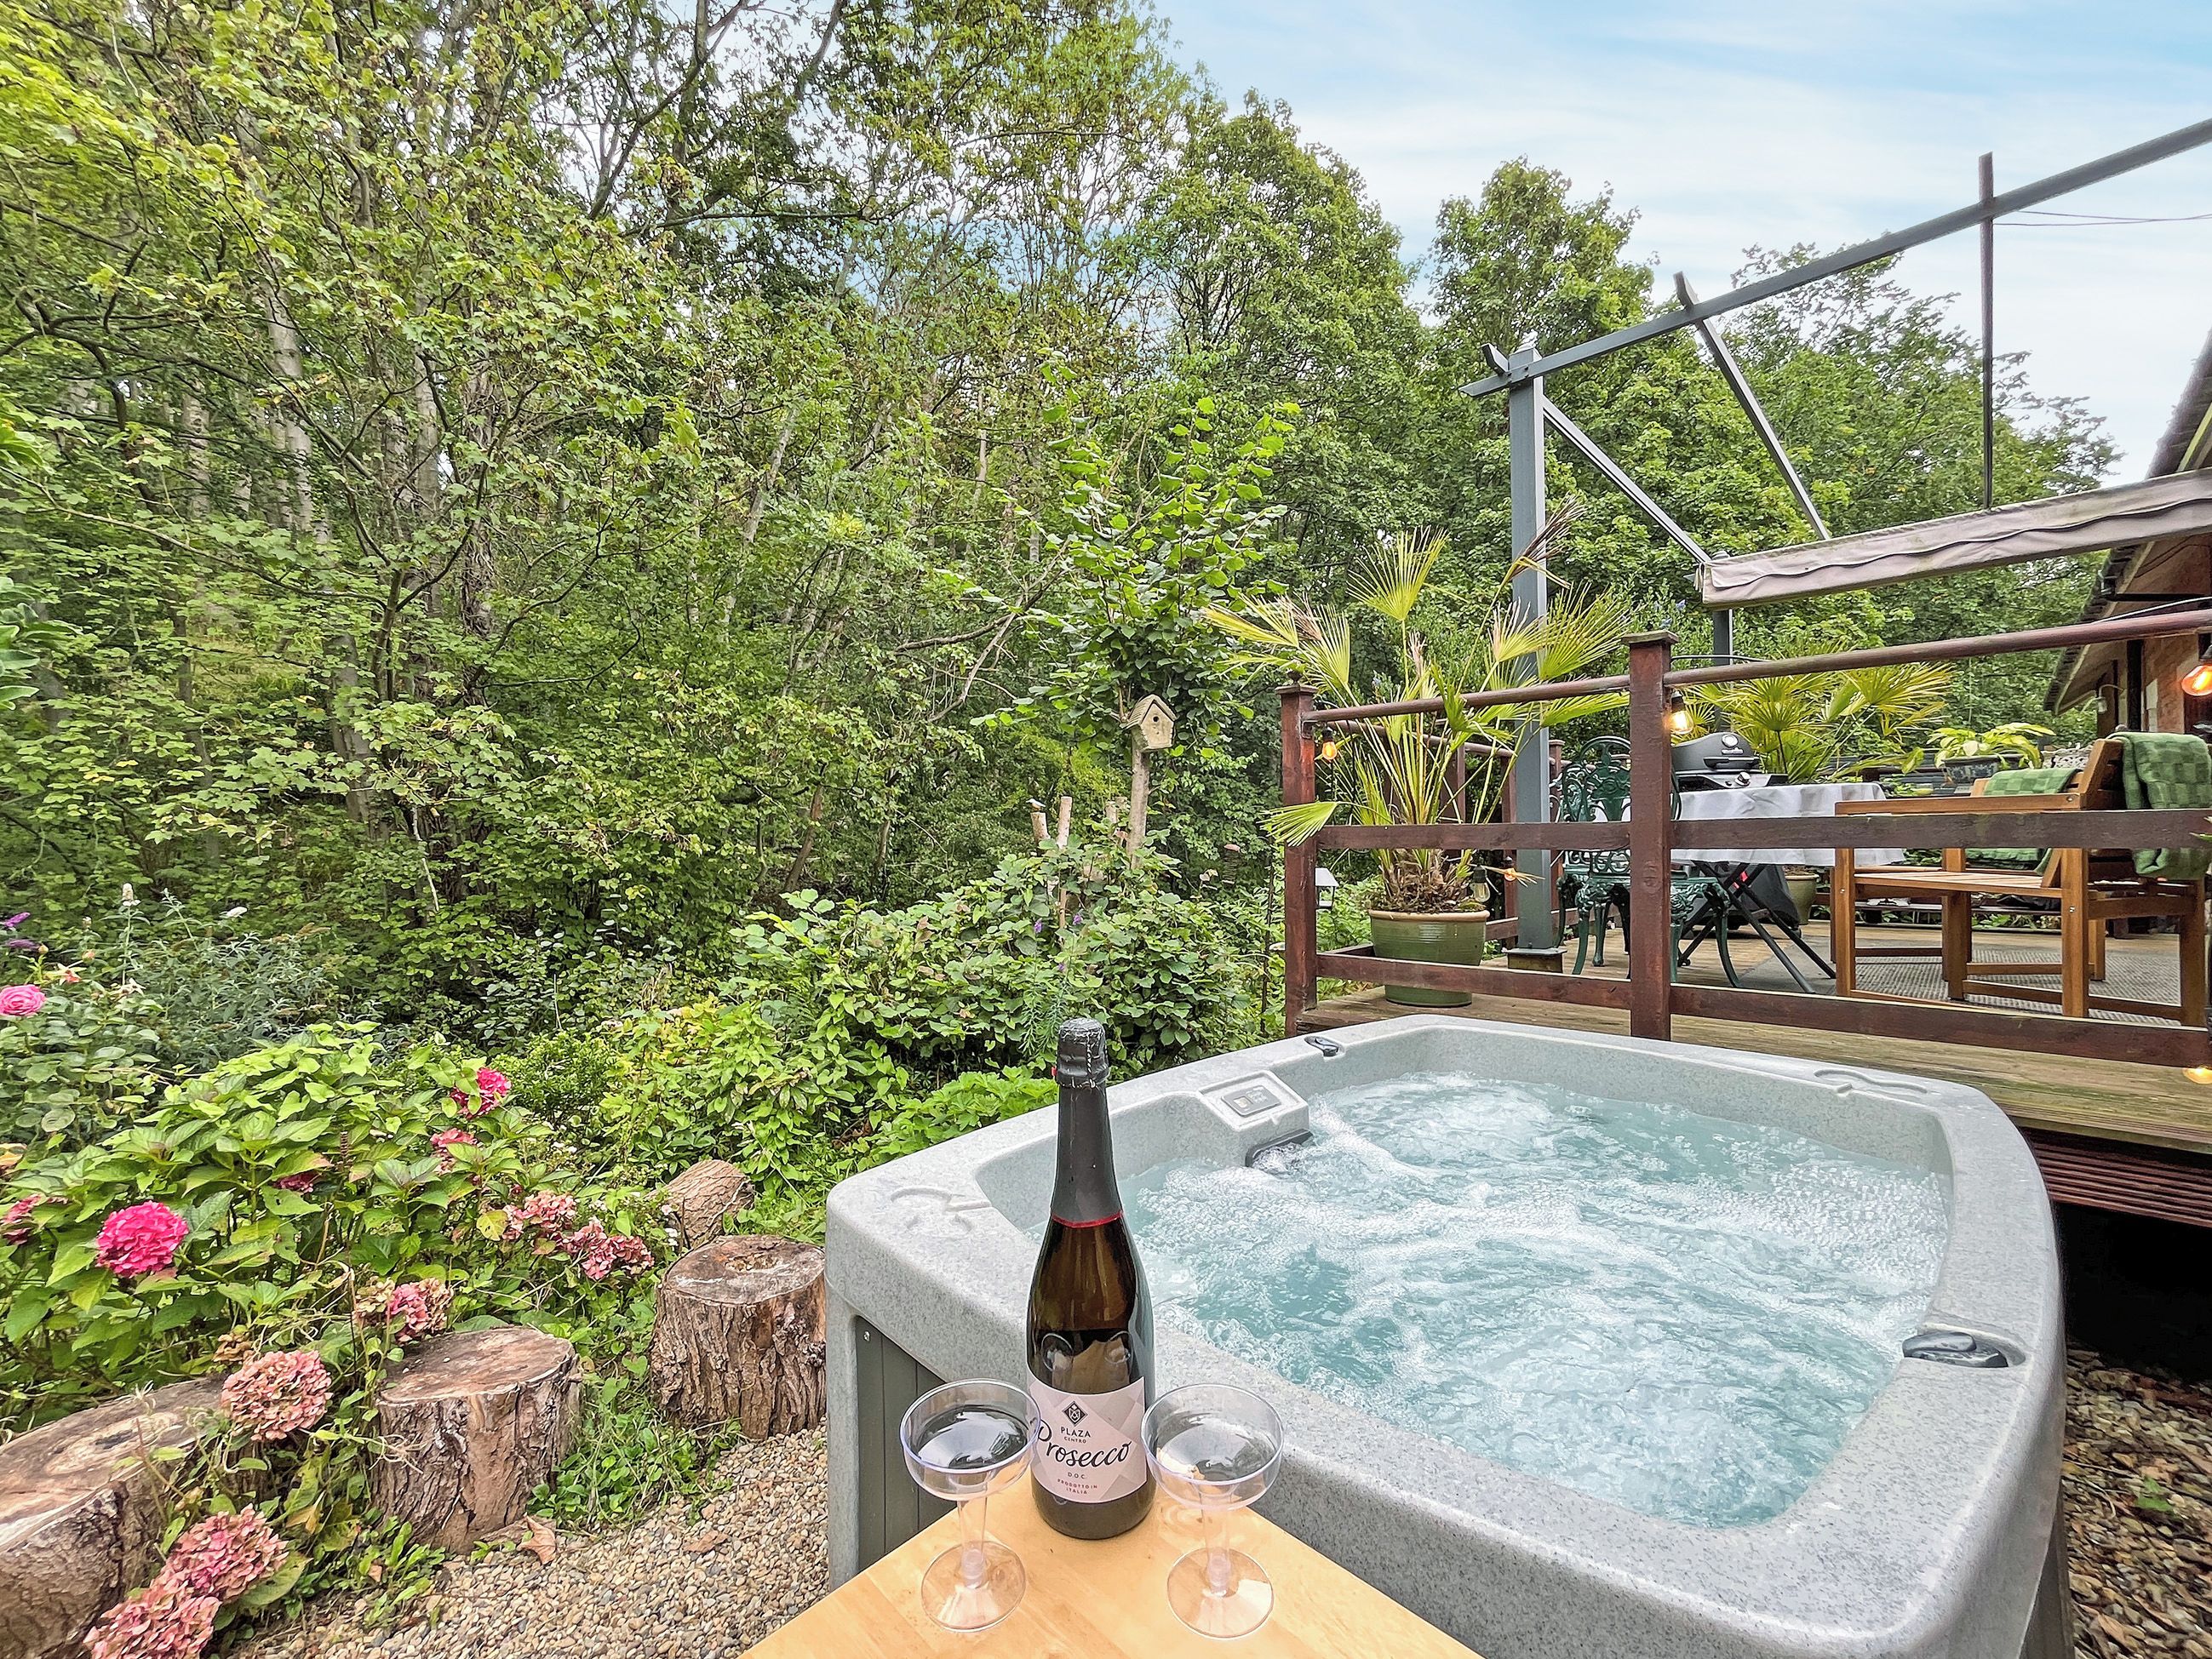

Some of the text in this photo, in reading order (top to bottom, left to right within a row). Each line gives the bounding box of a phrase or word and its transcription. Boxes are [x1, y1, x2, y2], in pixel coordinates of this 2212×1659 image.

[1060, 1427, 1091, 1438] PLAZA
[1033, 1418, 1132, 1467] Prosecco
[1057, 1479, 1090, 1490] PRODOTTO
